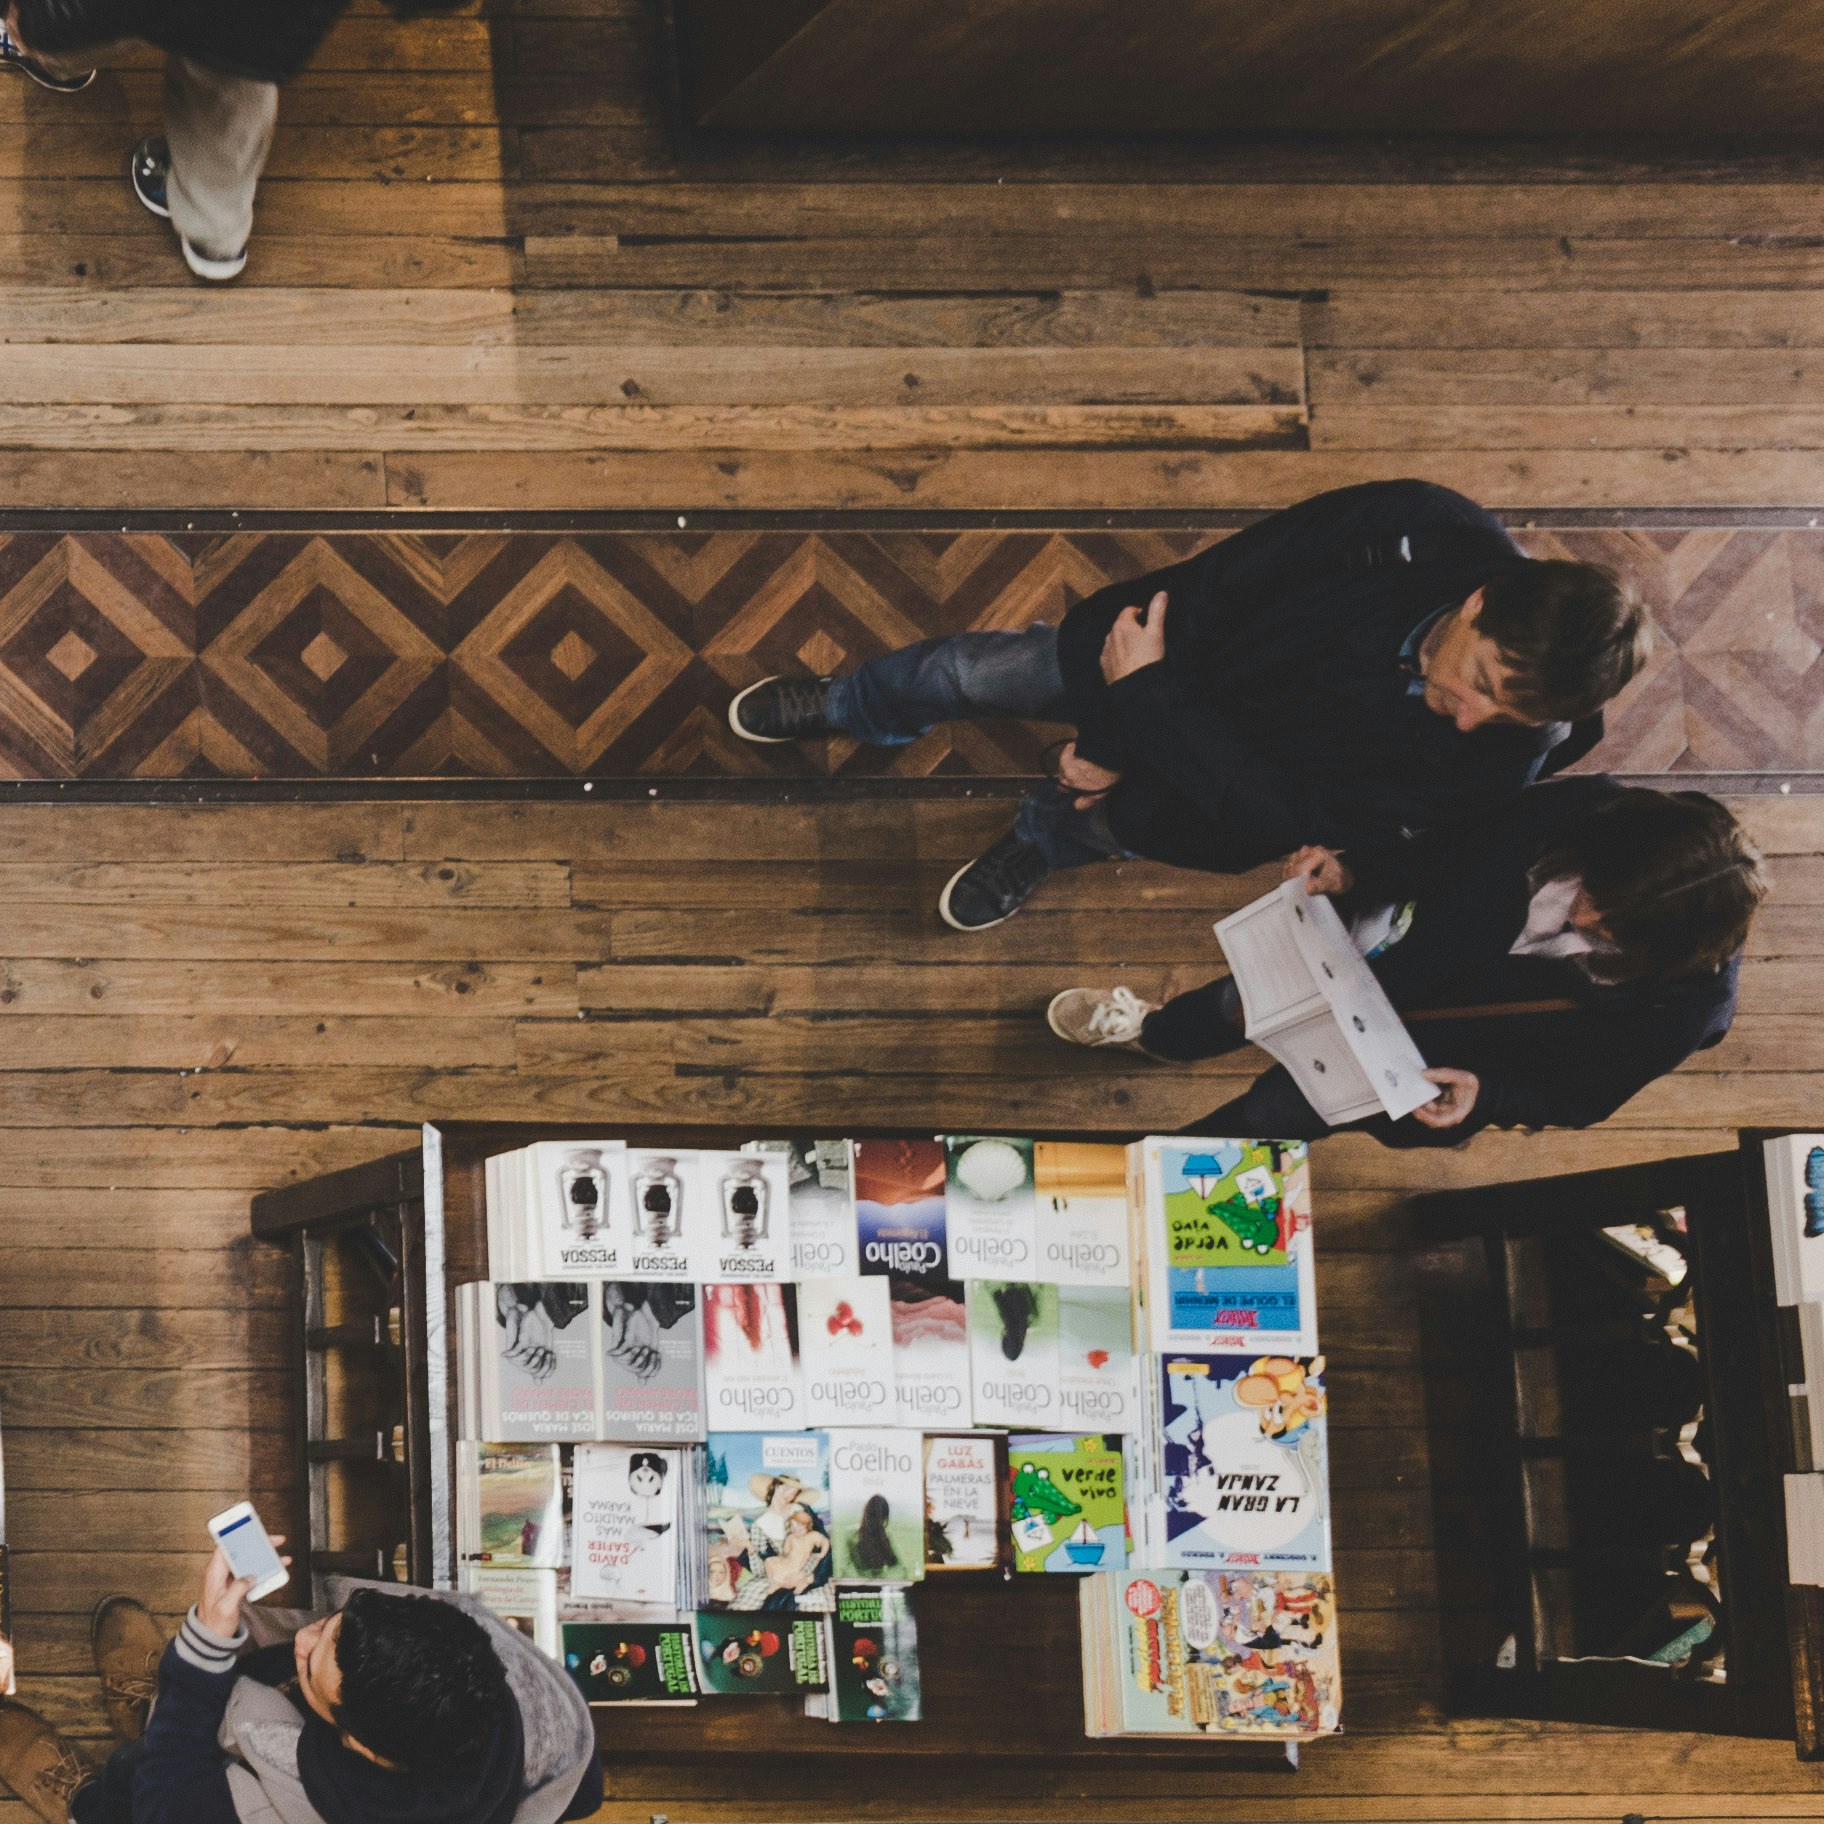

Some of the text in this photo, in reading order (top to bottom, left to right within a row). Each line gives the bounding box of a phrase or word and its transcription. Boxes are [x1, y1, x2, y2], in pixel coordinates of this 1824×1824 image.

[561, 1248, 617, 1264] PESSOA
[866, 1241, 942, 1267] Coelho
[955, 1236, 1029, 1263] Coelho
[1047, 1243, 1120, 1268] Coelho
[633, 1255, 688, 1273] PESSOA
[719, 1257, 775, 1273] PESSOA
[720, 1386, 795, 1411] Coelho
[811, 1380, 887, 1405] Coelho
[982, 1381, 1053, 1408] Coelho
[765, 1447, 815, 1459] CUENTOS
[833, 1445, 912, 1473] Coelho
[947, 1445, 973, 1456] LUZ
[929, 1474, 992, 1485] PALMERAS
[1061, 1466, 1118, 1484] verde
[1216, 1473, 1282, 1491] ZANJA
[1079, 1486, 1118, 1500] vivo
[587, 1500, 632, 1513] KARMA
[942, 1497, 979, 1509] NIEVE
[1218, 1495, 1301, 1513] LA GRAN
[582, 1511, 636, 1524] MALDITO
[587, 1539, 630, 1553] SAFIER
[588, 1553, 630, 1566] DAVID
